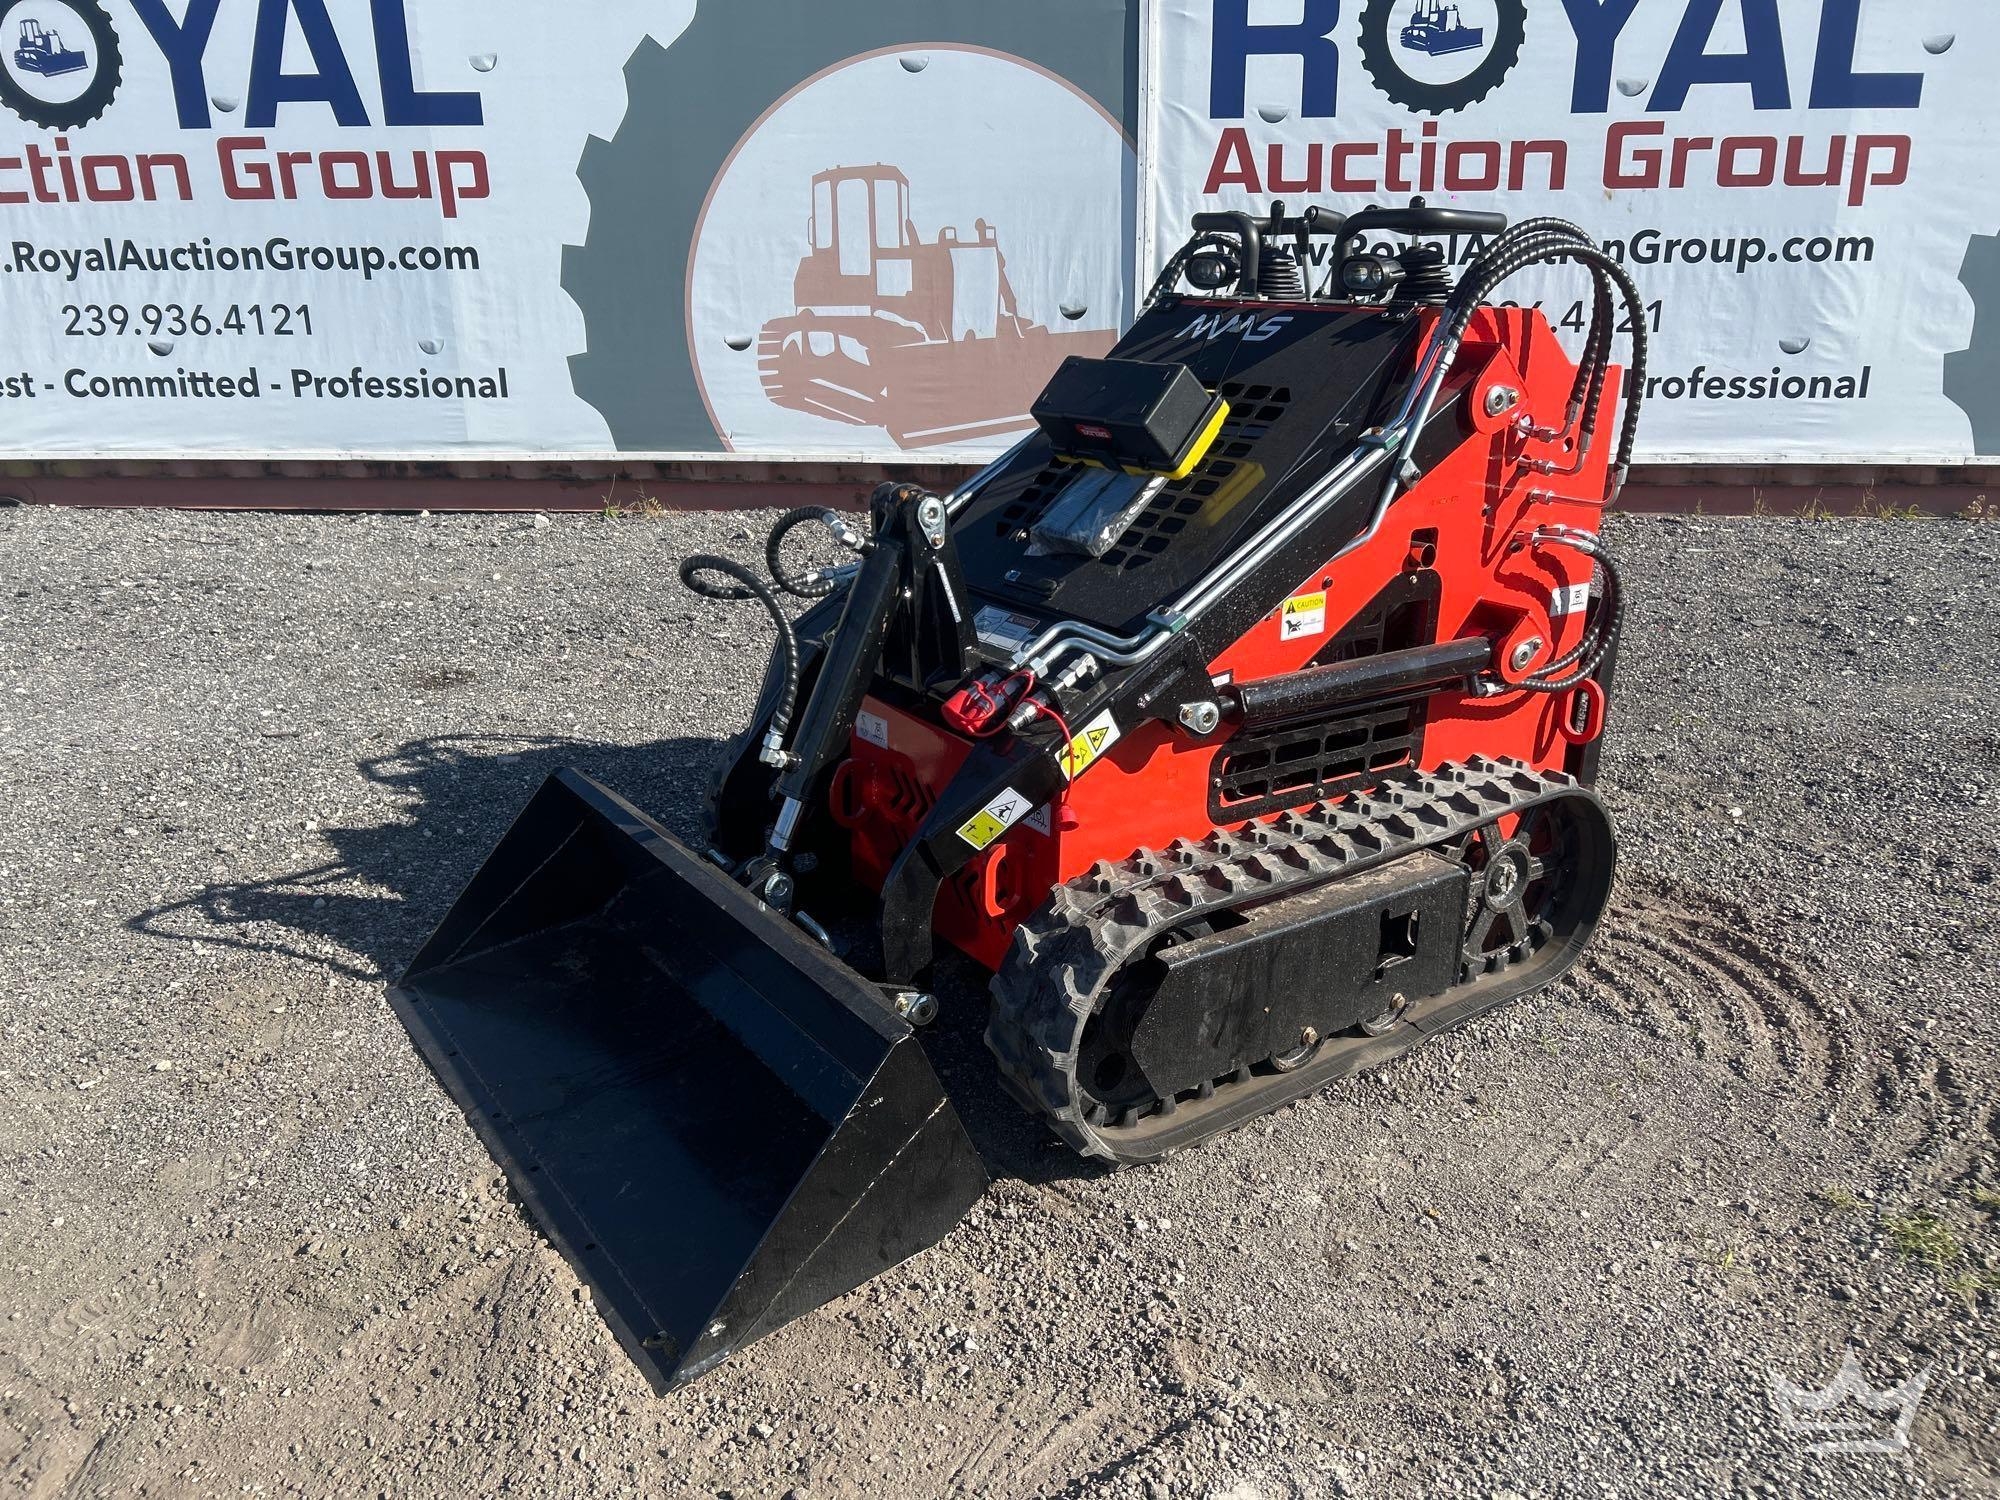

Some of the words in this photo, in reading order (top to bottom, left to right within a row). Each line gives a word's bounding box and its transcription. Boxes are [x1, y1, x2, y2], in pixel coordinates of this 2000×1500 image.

[216, 136, 491, 219] Group
[1202, 121, 1567, 194] Auction
[1602, 120, 1912, 206] Group
[4, 237, 480, 281] .RoyalAuctionGroup.com
[61, 303, 314, 336] 239.936.4121
[0, 371, 36, 398] st
[64, 367, 261, 398] Committed
[291, 367, 510, 398] Professional
[1296, 597, 1325, 610] CAUTION
